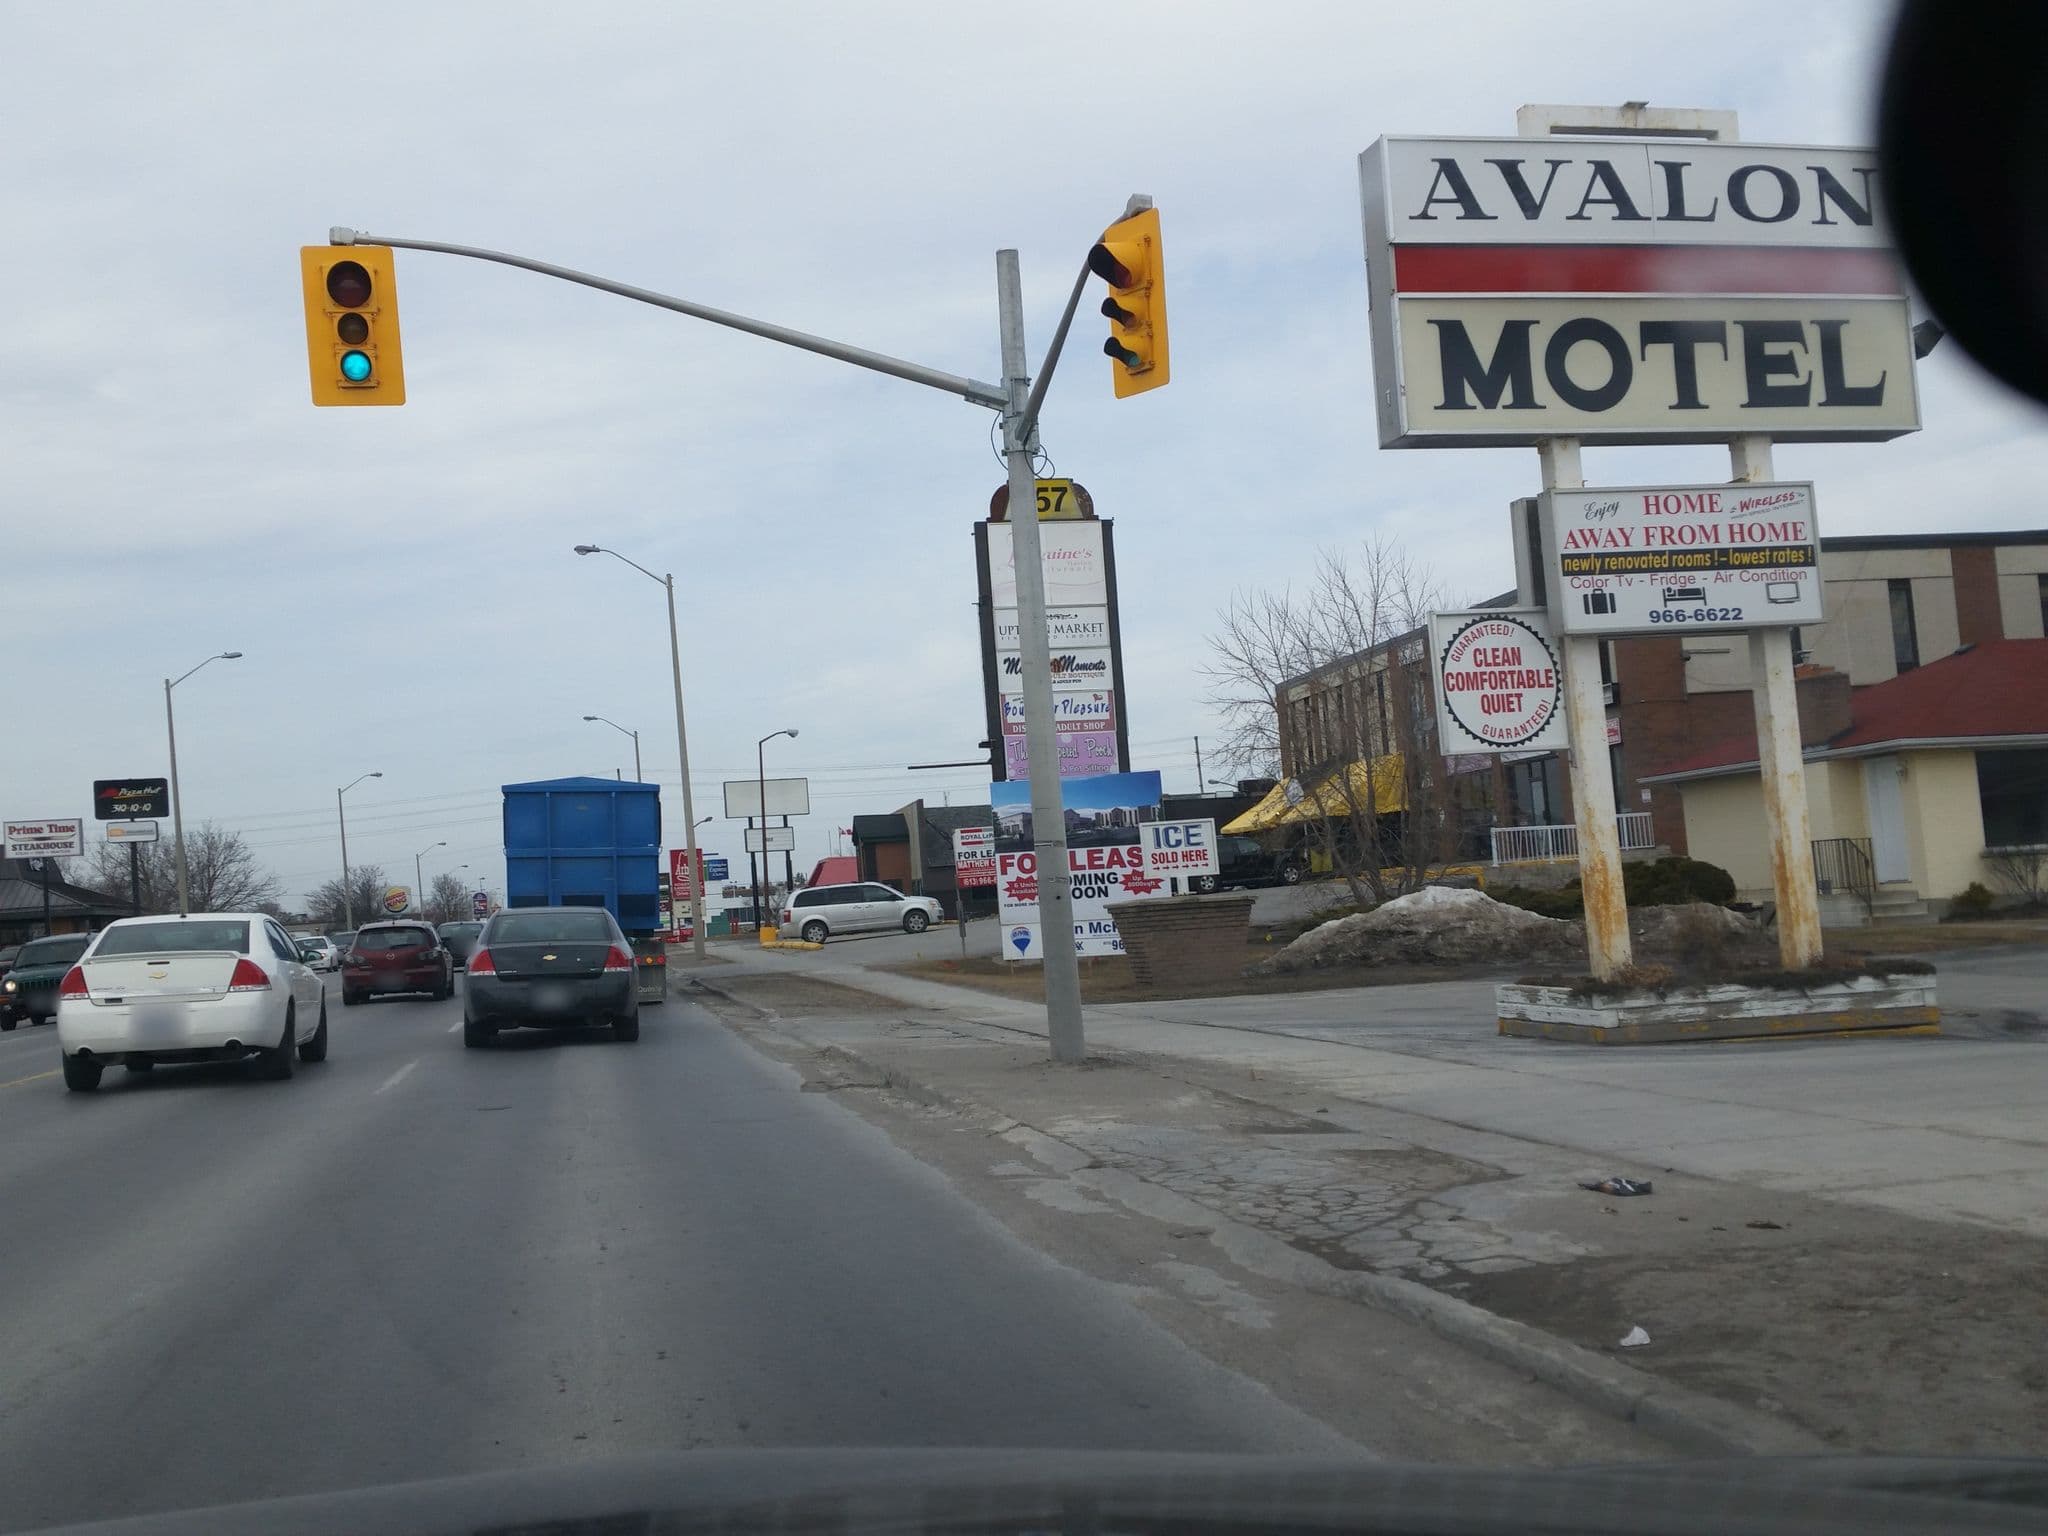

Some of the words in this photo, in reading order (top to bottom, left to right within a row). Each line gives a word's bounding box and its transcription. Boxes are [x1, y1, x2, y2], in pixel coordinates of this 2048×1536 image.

[1408, 157, 1880, 226] AVALON
[1427, 317, 1887, 413] MOTEL
[1584, 501, 1621, 521] Enjoy
[1643, 493, 1723, 515] HOME
[1740, 491, 1795, 513] WIRELESS
[1564, 527, 1635, 550] AWAY
[1643, 524, 1720, 547] FROM
[1728, 521, 1808, 544] HOME
[1564, 554, 1602, 575] newly
[1605, 551, 1669, 571] renovated
[1728, 547, 1770, 565] lowest
[1570, 576, 1610, 589] Color
[1615, 574, 1634, 587] Tv
[1650, 572, 1696, 588] Fridge
[1714, 571, 1734, 583] Air
[1740, 568, 1808, 583] Condition
[1649, 607, 1744, 624] 966-6622
[1054, 622, 1105, 635] MARKET
[1451, 624, 1515, 662] GUARANTEED!
[1059, 655, 1107, 673] Moments
[1473, 647, 1522, 668] CLEAN
[1445, 669, 1554, 692] COMFORTABLE
[1062, 698, 1112, 715] Pleasure
[1481, 693, 1523, 716] QUIET
[1056, 722, 1081, 731] ADULT
[1083, 721, 1106, 730] SHOP
[1482, 699, 1551, 739] GUARANTEED!
[8, 825, 44, 835] Prime
[47, 824, 76, 834] Time
[1153, 824, 1205, 849] ICE
[11, 841, 75, 851] STEAKHOUSE
[957, 851, 978, 860] FOR
[1151, 852, 1178, 864] SOLD
[1181, 849, 1208, 862] HERE
[957, 859, 989, 869] MATTHEW
[999, 853, 1038, 875] FO
[1069, 846, 1144, 871] LEAS
[1071, 886, 1110, 900] OON
